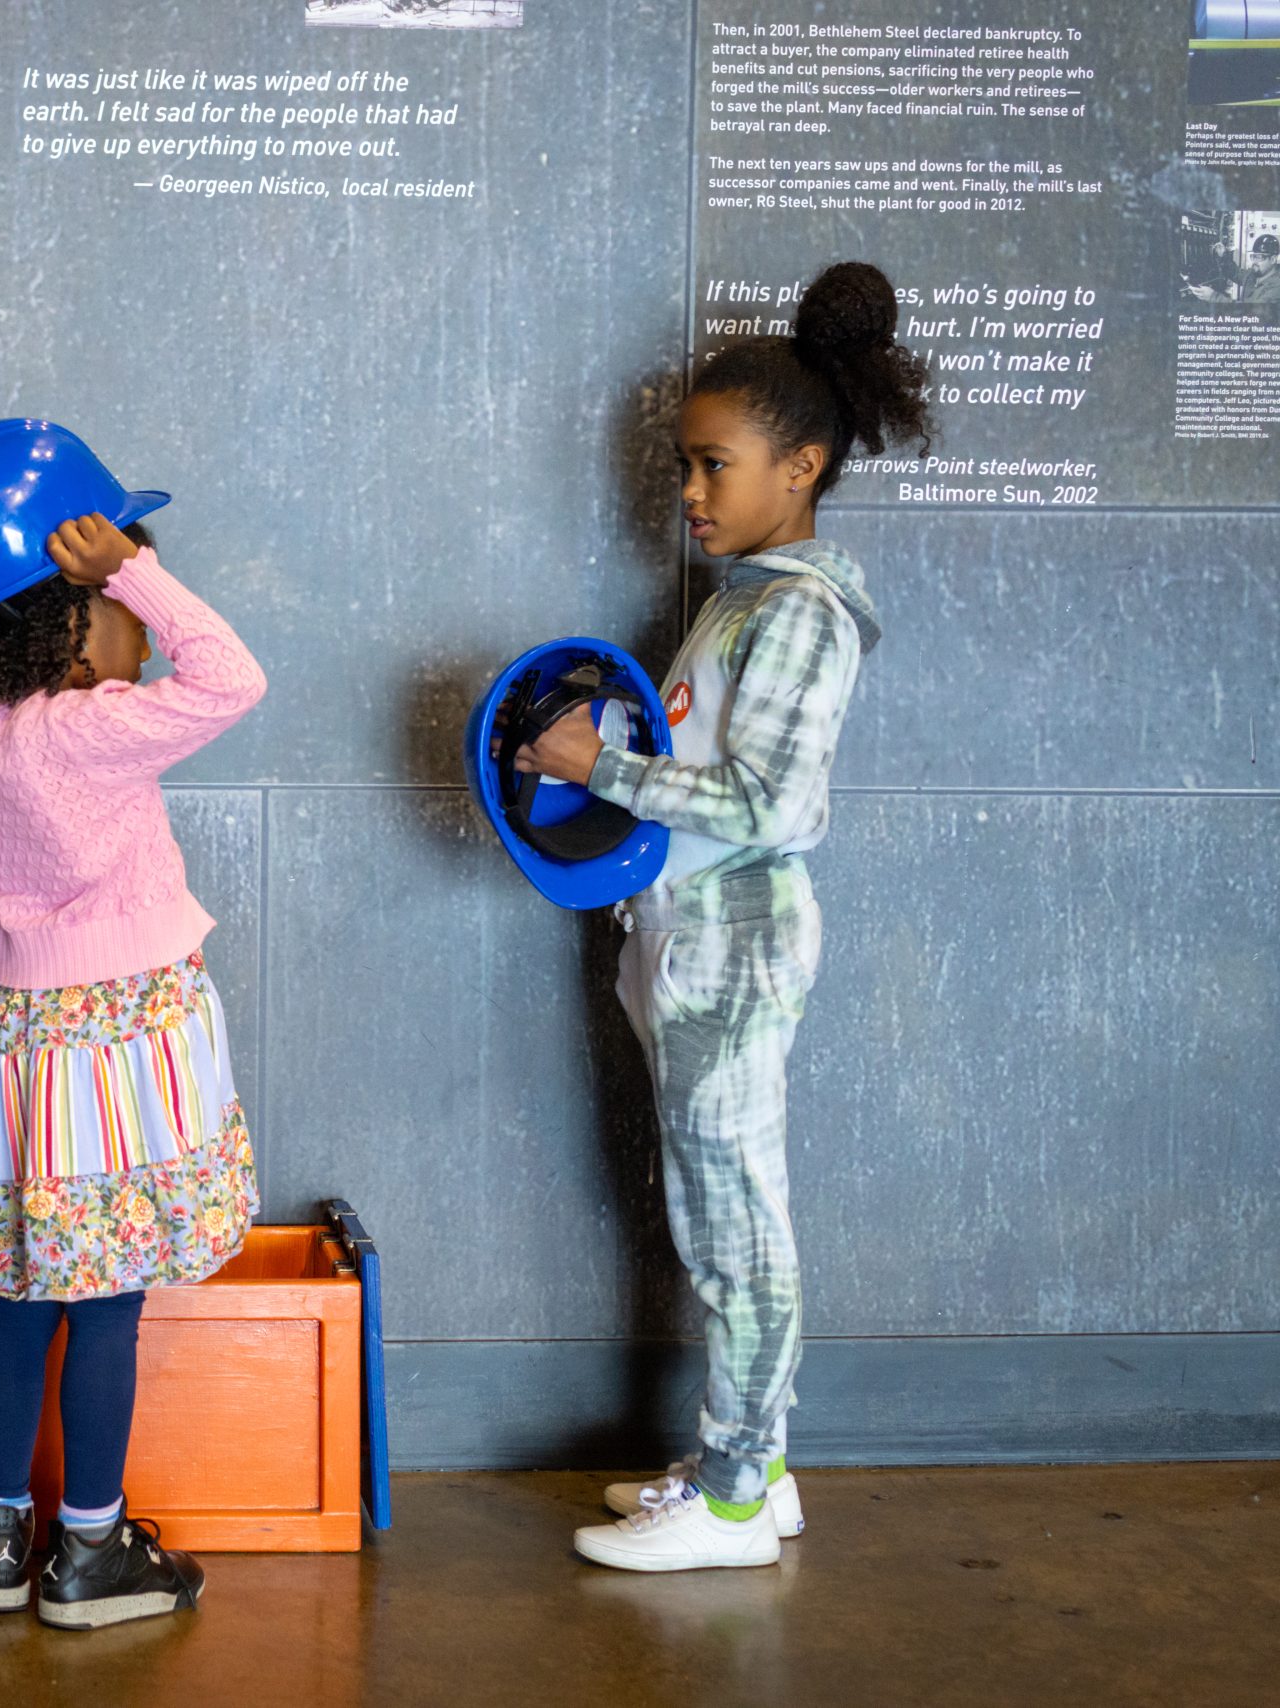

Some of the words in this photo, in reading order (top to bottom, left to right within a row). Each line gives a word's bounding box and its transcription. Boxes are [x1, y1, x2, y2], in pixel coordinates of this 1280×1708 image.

[712, 22, 750, 38] Then,
[753, 23, 766, 37] in
[769, 23, 805, 39] 2001,
[808, 24, 882, 38] Bethlehem
[885, 25, 920, 39] Steel
[923, 26, 982, 40] declared
[985, 27, 1063, 44] bankruptcy.
[1066, 28, 1082, 41] To
[711, 43, 757, 55] attract
[759, 45, 768, 56] a
[771, 42, 813, 59] buyer,
[816, 43, 838, 57] the
[841, 47, 901, 60] company
[904, 45, 975, 59] eliminated
[978, 46, 1024, 59] retiree
[1027, 46, 1069, 60] health
[23, 67, 40, 89] It
[46, 73, 90, 89] was
[92, 68, 139, 95] just
[144, 68, 186, 90] like
[191, 69, 208, 90] it
[214, 74, 258, 91] was
[264, 69, 332, 97] wiped
[336, 70, 369, 92] off
[373, 70, 409, 92] the
[711, 60, 766, 75] benefits
[768, 62, 794, 75] and
[797, 63, 818, 76] cut
[821, 63, 885, 79] pensions,
[888, 64, 958, 81] sacrificing
[961, 64, 983, 78] the
[986, 68, 1016, 81] very
[1018, 65, 1064, 82] people
[1066, 66, 1094, 79] who
[711, 80, 754, 97] forged
[757, 80, 780, 94] the
[782, 81, 820, 95] mill's
[927, 83, 983, 97] workers
[986, 84, 1011, 97] and
[22, 100, 89, 122] earth.
[97, 100, 106, 122] I
[110, 100, 150, 122] felt
[154, 101, 197, 123] sad
[201, 101, 235, 123] for
[240, 102, 276, 124] the
[281, 102, 359, 129] people
[365, 103, 411, 125] that
[415, 103, 459, 125] had
[710, 99, 724, 112] to
[727, 102, 758, 113] save
[760, 100, 783, 113] the
[786, 100, 824, 116] plant.
[828, 100, 864, 117] Many
[866, 101, 903, 115] faced
[905, 102, 963, 116] financial
[966, 103, 997, 116] ruin.
[1001, 103, 1026, 116] The
[1029, 106, 1069, 117] sense
[1072, 104, 1086, 117] of
[710, 118, 766, 135] betrayal
[768, 122, 791, 132] ran
[794, 119, 831, 136] deep.
[22, 133, 45, 154] to
[49, 132, 97, 160] give
[103, 138, 131, 160] up
[137, 134, 258, 161] everything
[264, 136, 286, 156] to
[291, 140, 353, 157] move
[358, 137, 400, 157] out.
[708, 156, 734, 169] The
[737, 157, 766, 170] next
[769, 158, 791, 170] ten
[794, 160, 832, 173] years
[834, 161, 862, 171] saw
[864, 161, 889, 174] ups
[891, 159, 916, 172] and
[919, 159, 963, 172] downs
[966, 159, 986, 173] for
[988, 160, 1010, 173] the
[1013, 160, 1043, 175] mill,
[1047, 164, 1063, 174] as
[159, 174, 253, 198] Georgeen
[258, 176, 330, 199] Nistico,
[342, 177, 389, 197] local
[393, 179, 476, 198] resident
[708, 178, 777, 189] successor
[779, 176, 851, 193] companies
[854, 180, 891, 190] came
[893, 178, 918, 191] and
[921, 179, 958, 191] went.
[962, 178, 1009, 195] Finally,
[1012, 179, 1034, 192] the
[1038, 179, 1074, 193] mill's
[1077, 180, 1102, 193] last
[708, 197, 753, 209] owner,
[756, 194, 776, 208] RG
[778, 195, 817, 210] Steel,
[820, 195, 851, 209] shut
[853, 196, 875, 209] the
[878, 196, 913, 212] plant
[916, 197, 936, 210] for
[938, 197, 971, 213] good
[974, 197, 987, 210] in
[990, 198, 1026, 211] 2012.
[706, 279, 725, 302] If
[728, 280, 771, 302] this
[933, 283, 998, 305] who's
[1003, 284, 1068, 312] going
[1074, 286, 1096, 306] to
[705, 315, 762, 335] want
[906, 315, 961, 338] hurt.
[969, 316, 1006, 338] I'm
[1013, 317, 1104, 339] worried
[939, 349, 1002, 371] won't
[1007, 350, 1071, 372] make
[1076, 350, 1094, 372] it
[939, 383, 961, 404] to
[967, 382, 1045, 405] collect
[1050, 388, 1087, 410] my
[840, 459, 920, 475] parrows
[924, 456, 975, 475] Point
[978, 457, 1097, 480] steelworker,
[899, 482, 997, 503] Baltimore
[1002, 484, 1046, 506] Sun,
[1051, 485, 1098, 505] 2002
